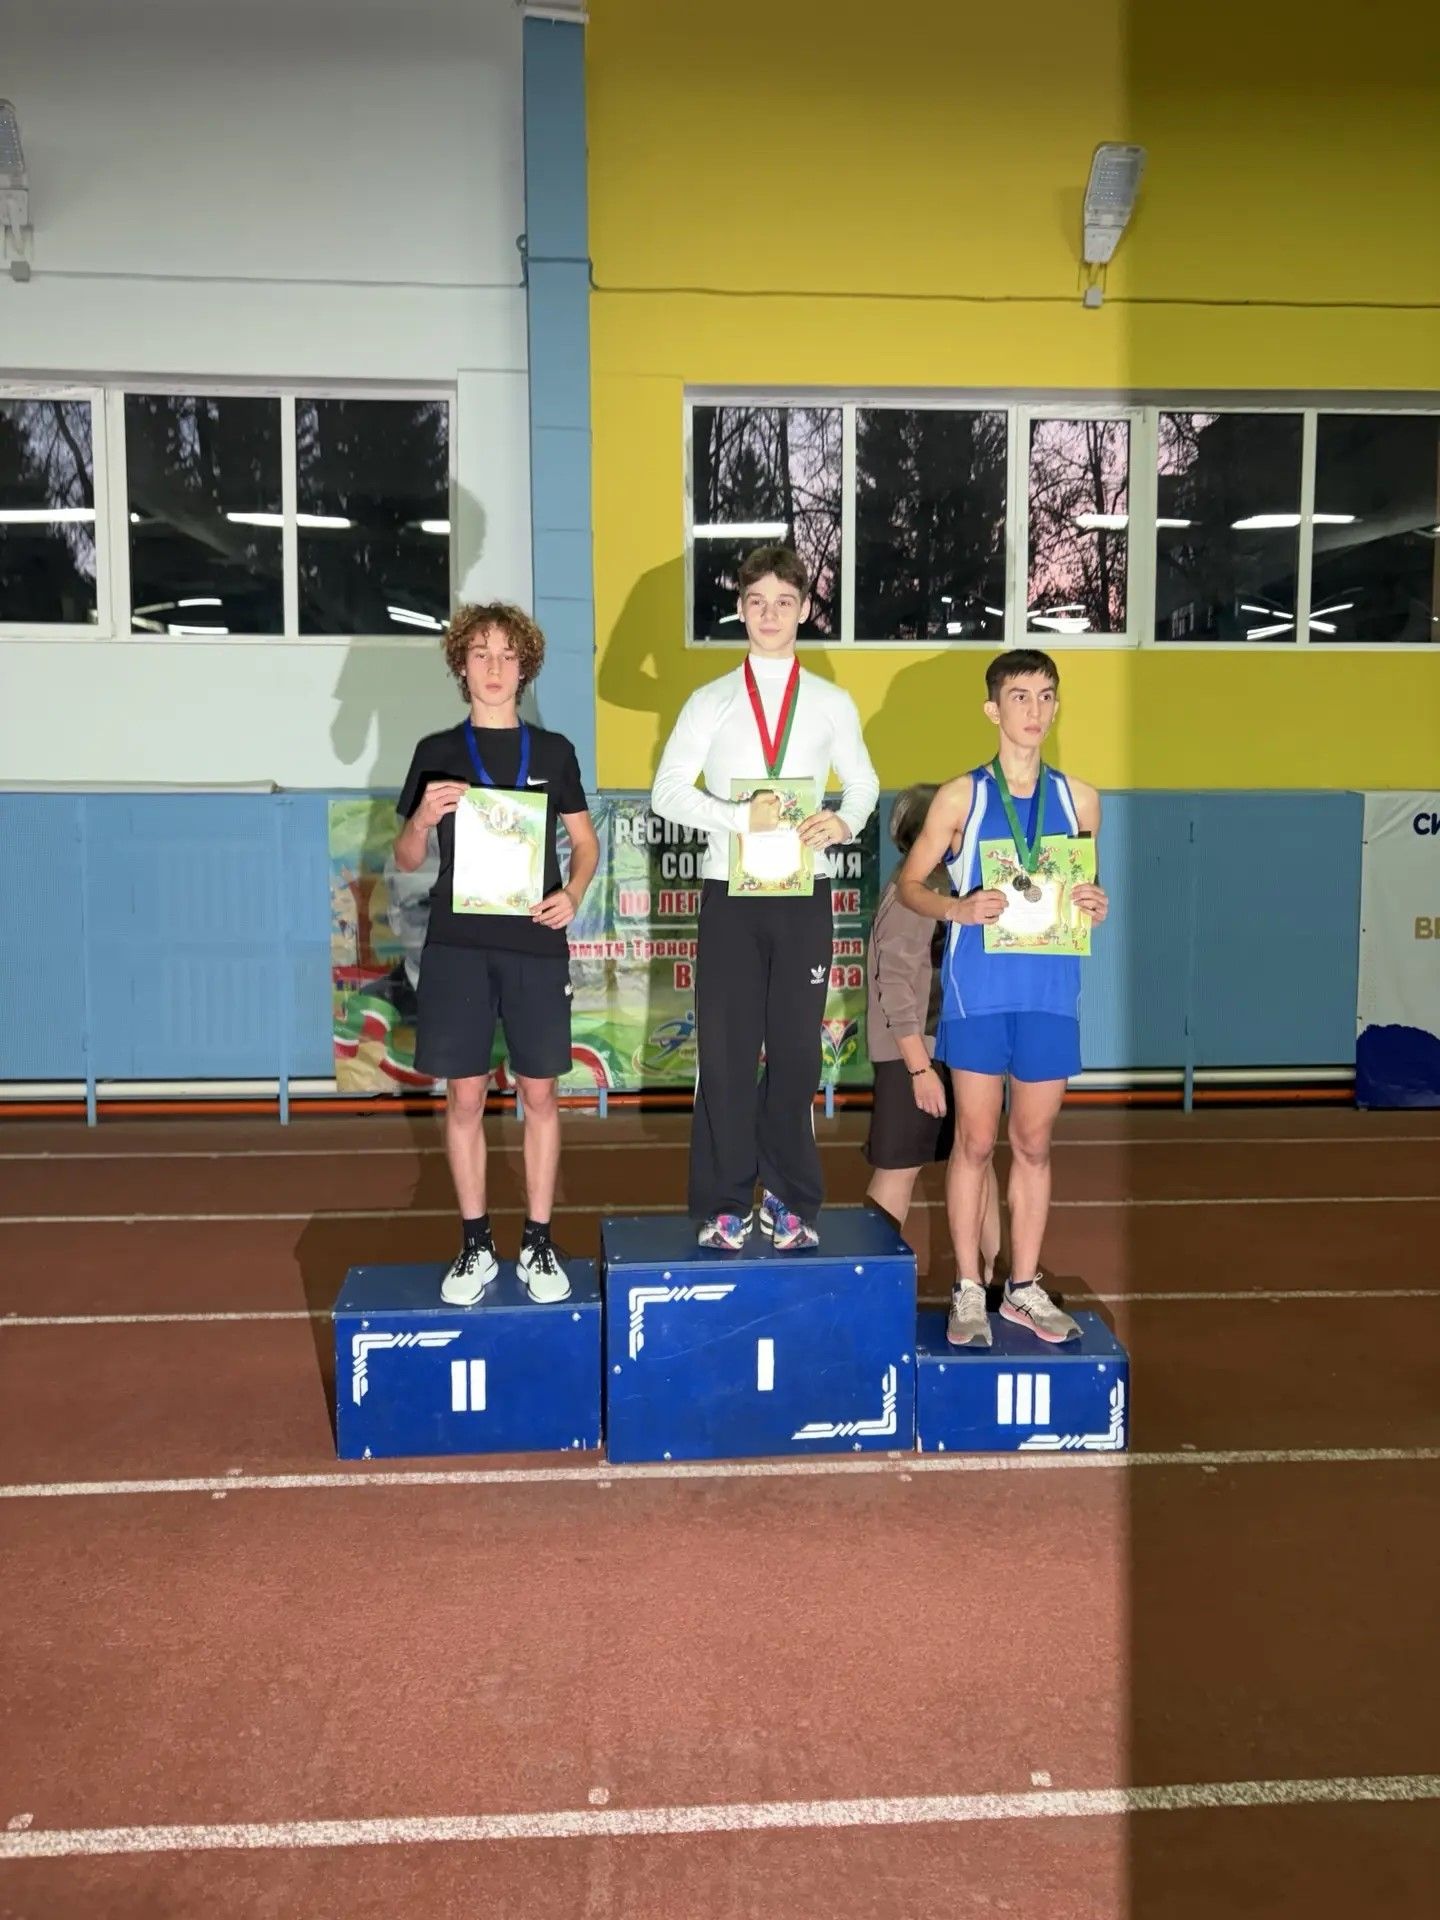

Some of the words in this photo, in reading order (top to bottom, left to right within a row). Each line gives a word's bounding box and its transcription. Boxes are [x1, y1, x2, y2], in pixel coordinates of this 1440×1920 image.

[661, 851, 704, 879] СО
[829, 852, 862, 879] ИЯ
[620, 890, 651, 917] ПО
[659, 889, 700, 916] ЛЕГ
[831, 889, 861, 916] КЕ
[632, 936, 698, 960] Тренер
[674, 962, 694, 991] В
[830, 965, 863, 989] ва
